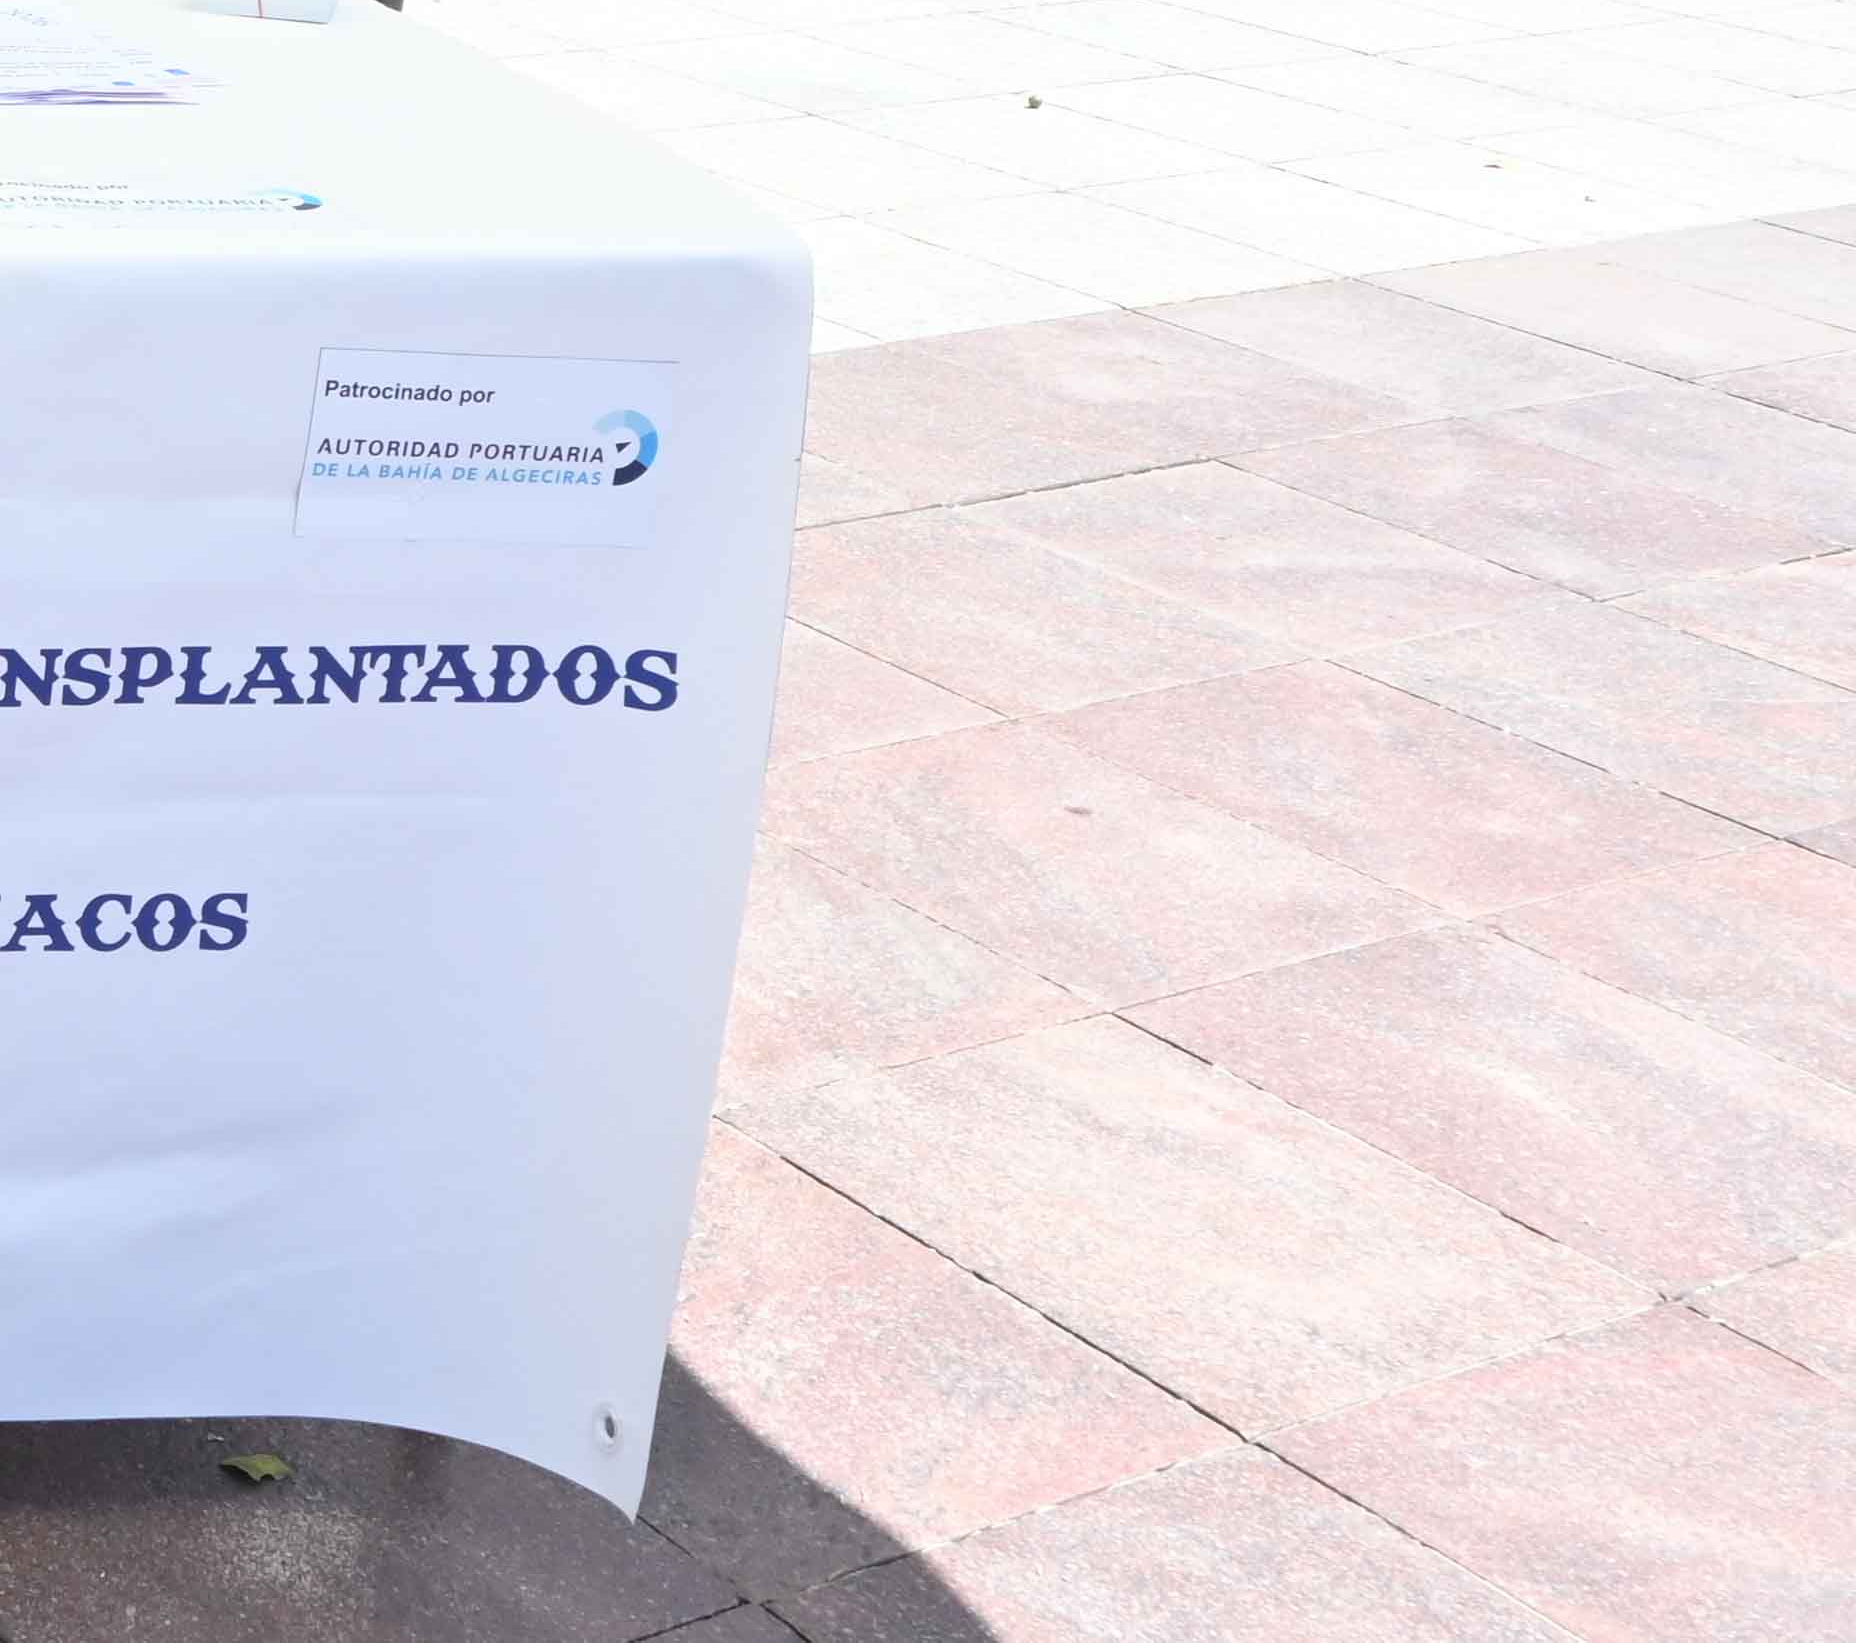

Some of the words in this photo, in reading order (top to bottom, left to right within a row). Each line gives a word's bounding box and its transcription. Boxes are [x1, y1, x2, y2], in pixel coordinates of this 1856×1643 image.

[324, 379, 453, 403] Patrocinado
[459, 387, 496, 407] por
[317, 437, 460, 459] AUTORIDAD
[468, 443, 605, 463] PORTUARIA
[311, 462, 339, 477] DE
[346, 463, 371, 478] LA
[378, 462, 443, 481] BAHÍA
[451, 466, 478, 482] DE
[486, 467, 603, 486] ALGECIRAS
